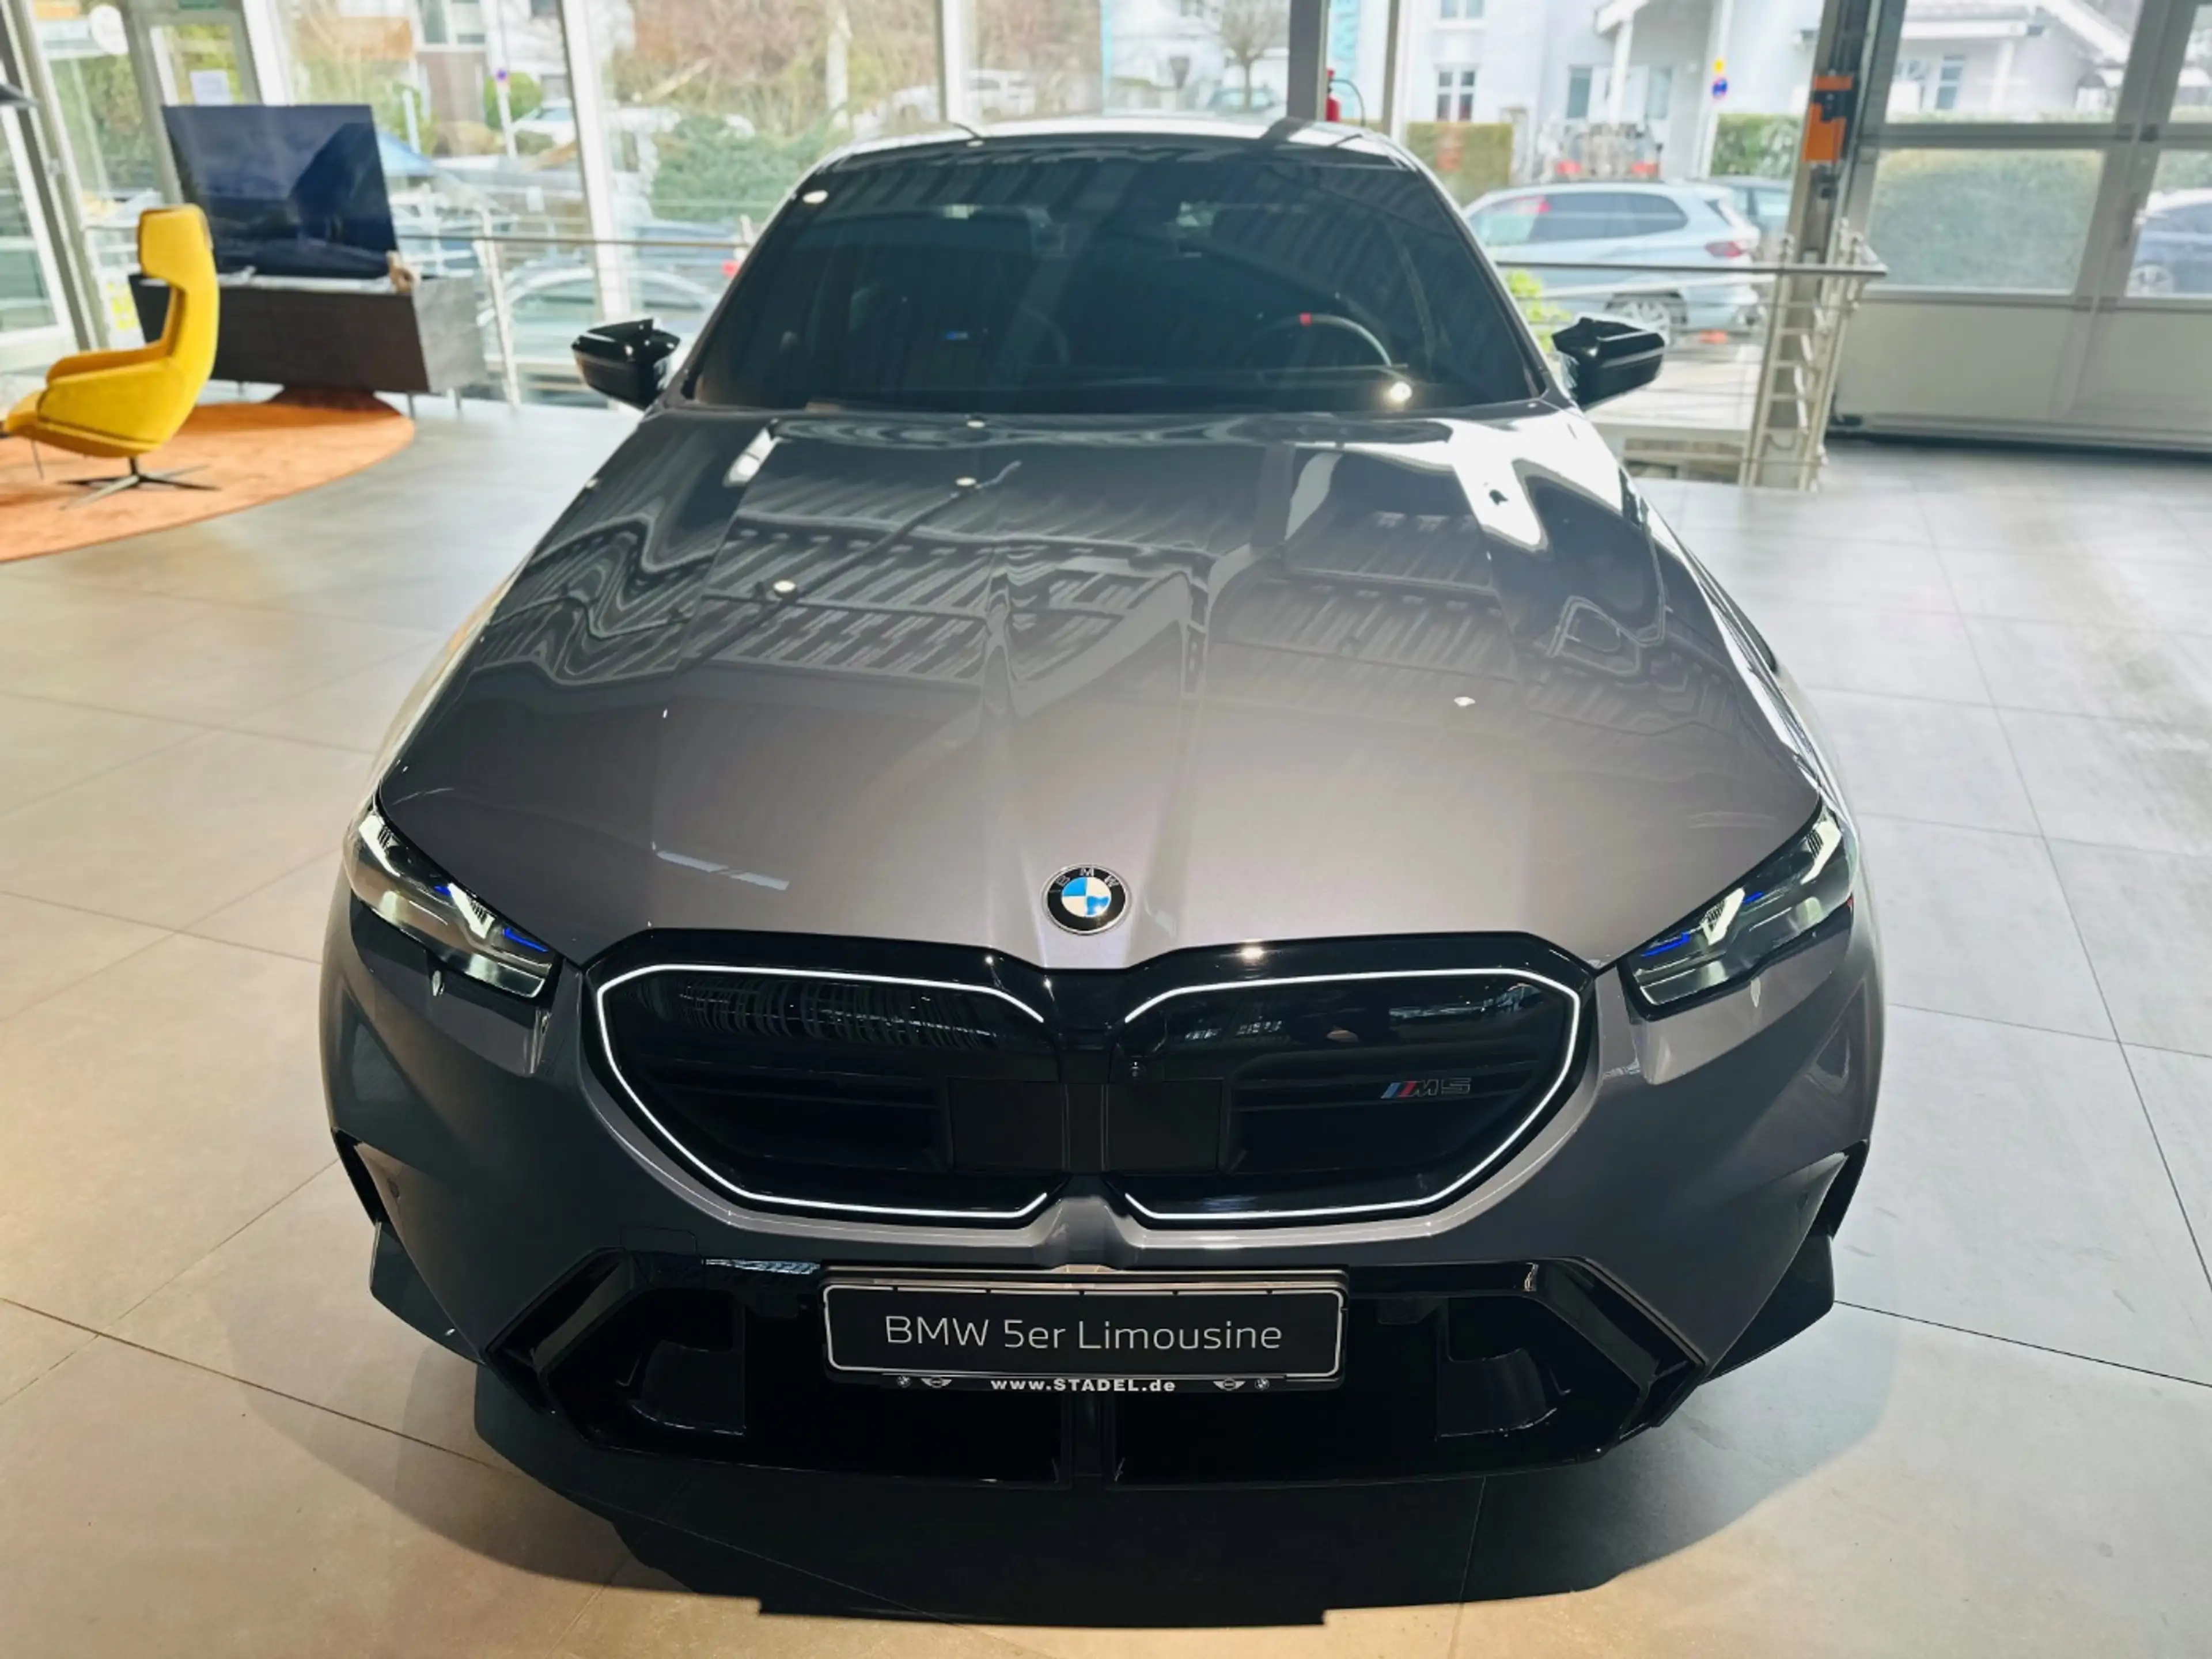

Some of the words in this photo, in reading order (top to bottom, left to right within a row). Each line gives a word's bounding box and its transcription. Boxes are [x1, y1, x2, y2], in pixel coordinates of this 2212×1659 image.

[1055, 867, 1120, 888] BMW
[1410, 1077, 1472, 1097] M5
[885, 1316, 989, 1347] BMW
[1004, 1319, 1066, 1349] 5er
[1078, 1320, 1282, 1349] Limousine
[990, 1378, 1176, 1392] www.STADEL.de
